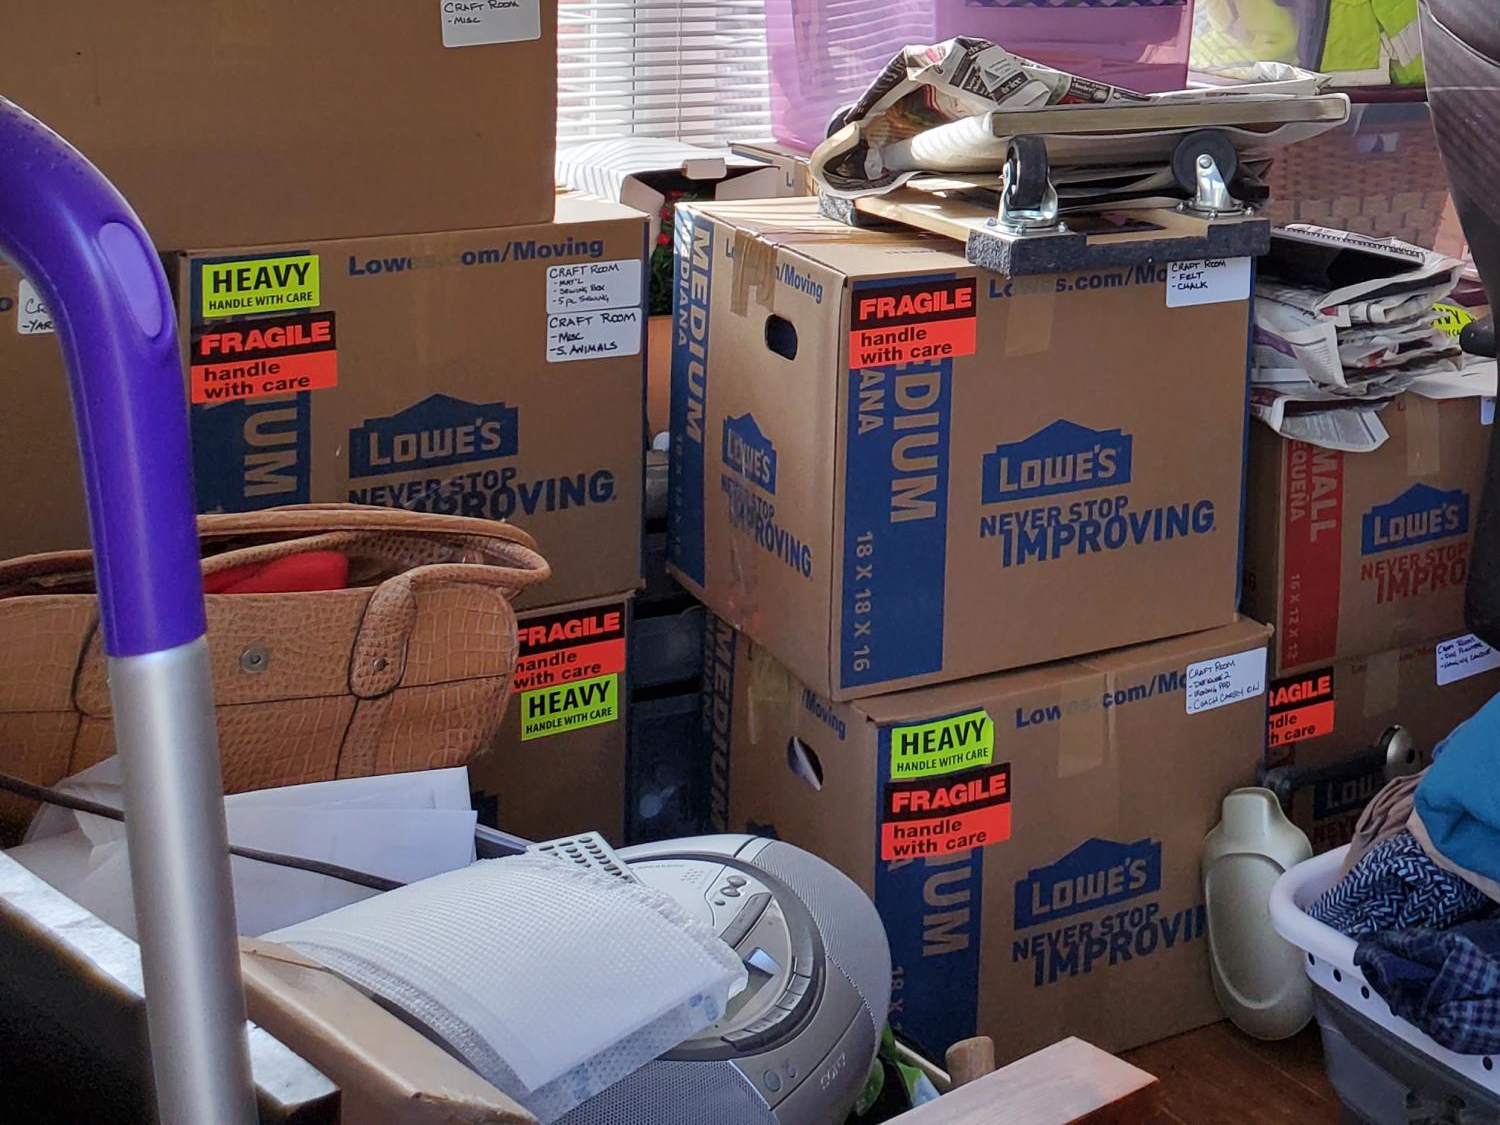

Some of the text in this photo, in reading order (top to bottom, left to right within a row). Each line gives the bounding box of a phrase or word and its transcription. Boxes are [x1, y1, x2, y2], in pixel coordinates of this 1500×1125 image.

[444, 0, 520, 13] CRAFT ROOM
[212, 261, 312, 295] HEAVY
[549, 263, 620, 279] CRAFT ROOM
[208, 290, 313, 311] HANDLE WITH CARE
[858, 287, 973, 321] FRAGILE
[549, 312, 637, 329] CRAFT ROOM
[200, 321, 331, 356] FRAGILE
[686, 226, 713, 444] MEDIUM
[859, 327, 928, 348] handle
[859, 341, 954, 365] with care
[203, 361, 281, 383] handle
[204, 375, 311, 399] with care
[369, 418, 502, 467] LOWE'S
[998, 445, 1119, 494] LOWE'S
[979, 495, 1130, 539] NEVER STOP
[1373, 502, 1461, 546] LOWE'S
[855, 531, 874, 557] 18
[1001, 499, 1218, 569] IMPROVING
[1360, 553, 1419, 583] NEVER
[854, 589, 873, 615] 18
[853, 645, 871, 672] 16
[513, 663, 602, 690] with care
[528, 680, 611, 719] HEAVY
[525, 706, 613, 735] HANDLE WITH CARE
[1283, 724, 1316, 741] care
[900, 716, 988, 757] HEAVY
[896, 747, 990, 773] HANDLE WITH CARE
[891, 772, 1008, 814] FRAGILE
[892, 818, 963, 841] handle
[892, 830, 987, 858] with care
[1031, 856, 1148, 916] LOWE'S
[1011, 902, 1161, 963] NEVER STOP
